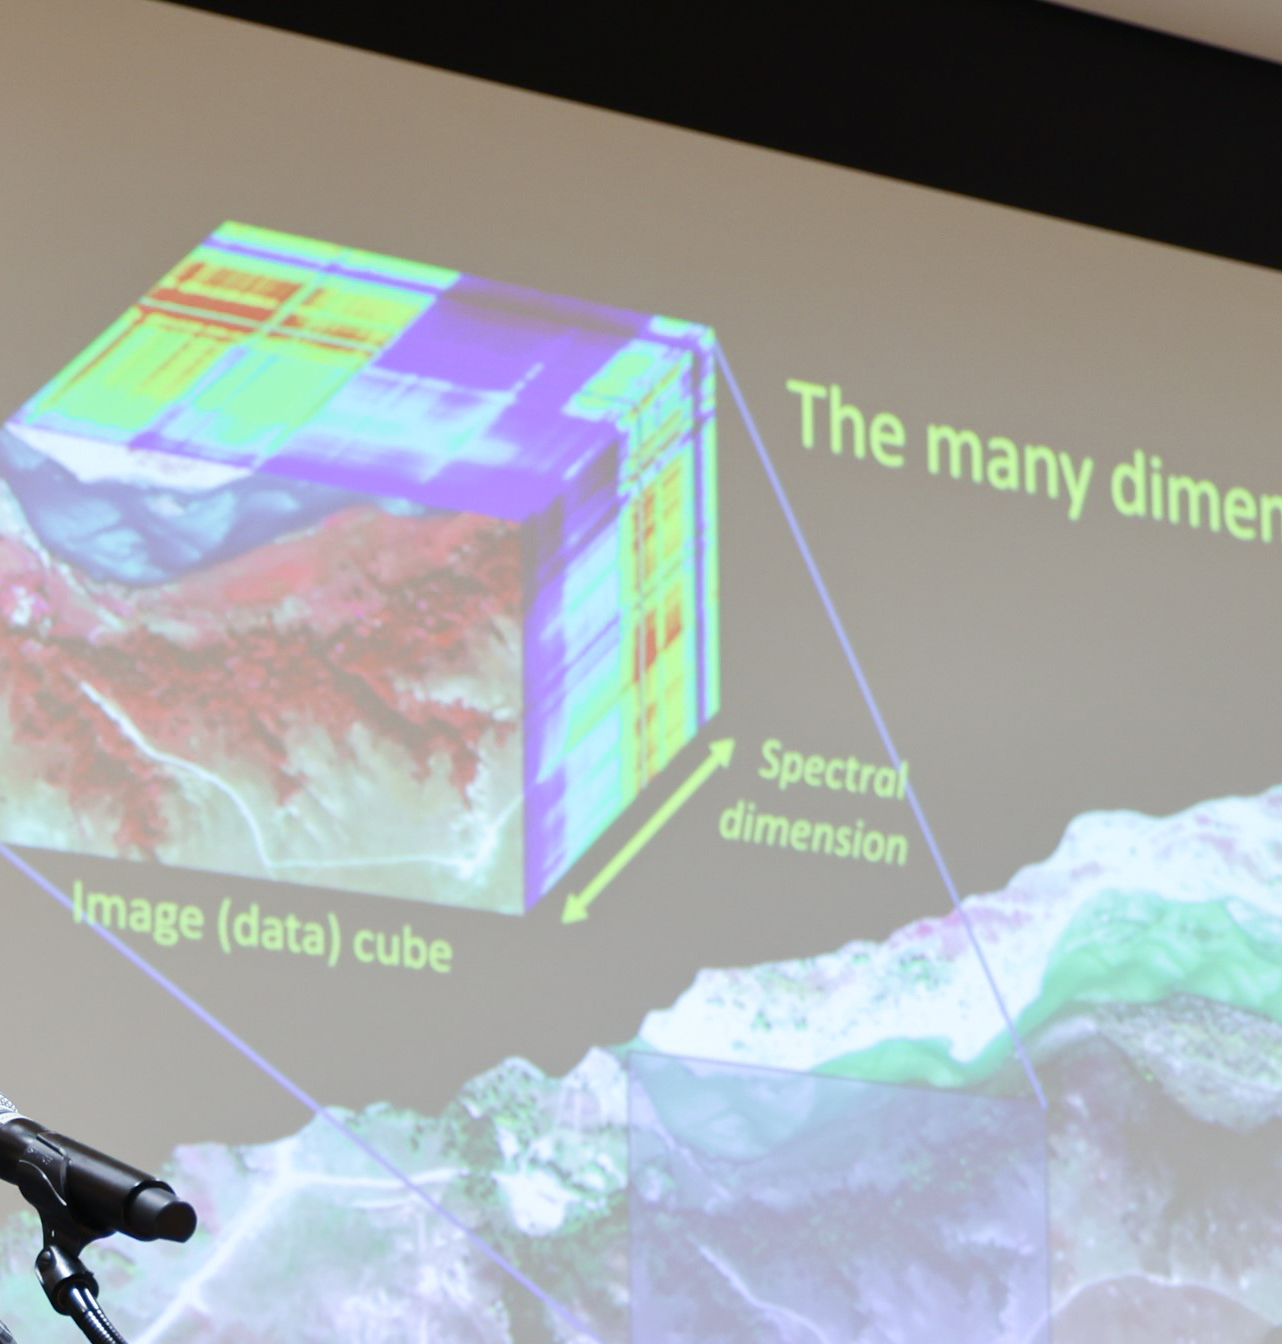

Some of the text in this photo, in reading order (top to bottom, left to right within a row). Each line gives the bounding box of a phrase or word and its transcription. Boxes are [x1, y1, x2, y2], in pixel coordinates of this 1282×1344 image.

[786, 378, 906, 467] The
[927, 423, 1093, 522] many
[758, 738, 909, 800] Spectral
[719, 798, 908, 867] dimension
[73, 879, 453, 973] Image (data) cube
